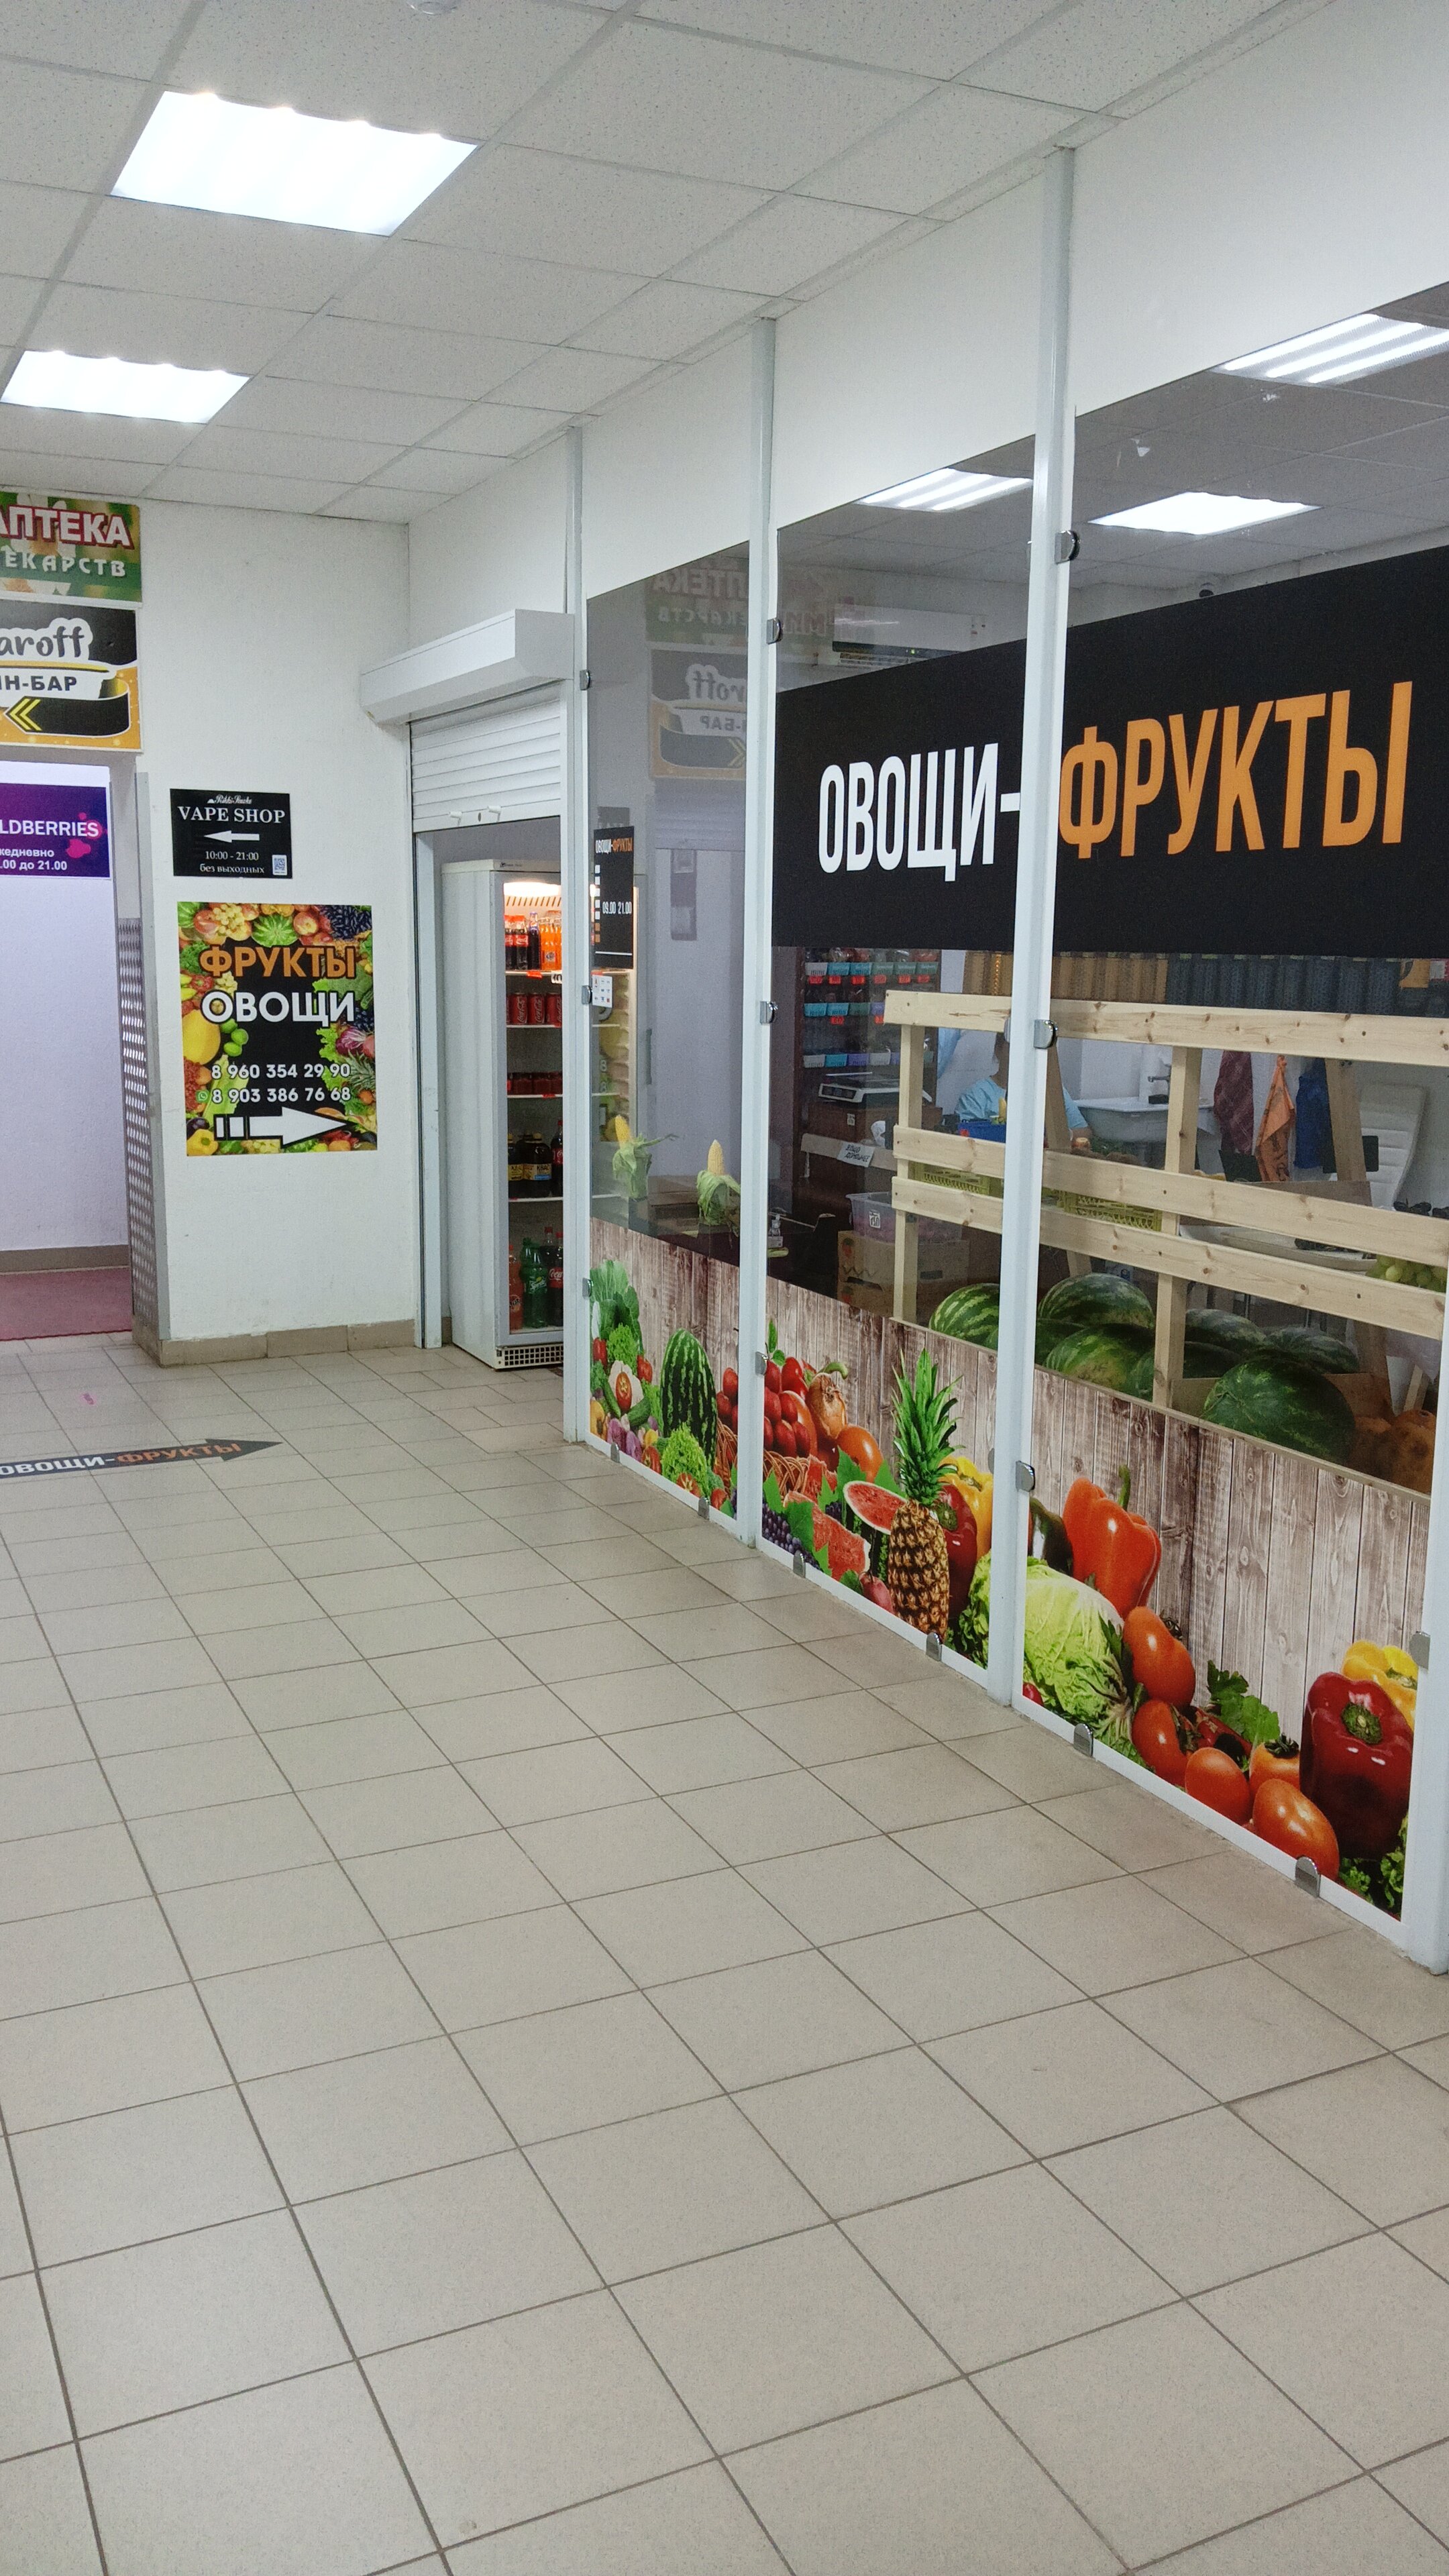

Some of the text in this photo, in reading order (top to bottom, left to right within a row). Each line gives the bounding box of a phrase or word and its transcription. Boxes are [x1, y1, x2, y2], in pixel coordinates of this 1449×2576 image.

[1059, 681, 1413, 860] ФРУКТЫ
[177, 806, 286, 824] VAPE SHOP
[0, 819, 99, 837] LDBERRIES
[205, 851, 228, 860] 10:00
[235, 851, 259, 861] 21:00
[19, 862, 35, 871] до
[37, 861, 67, 871] 21.00
[199, 863, 265, 874] без выходных
[199, 945, 357, 978] ФРУКТЫ
[201, 991, 354, 1027] ОВОЩИ
[211, 1063, 351, 1079] 8 960 354 29 90
[211, 1087, 352, 1104] 8 903 386 76 68
[0, 1443, 242, 1475] ОВОЩИ-ФРУКТЫ
